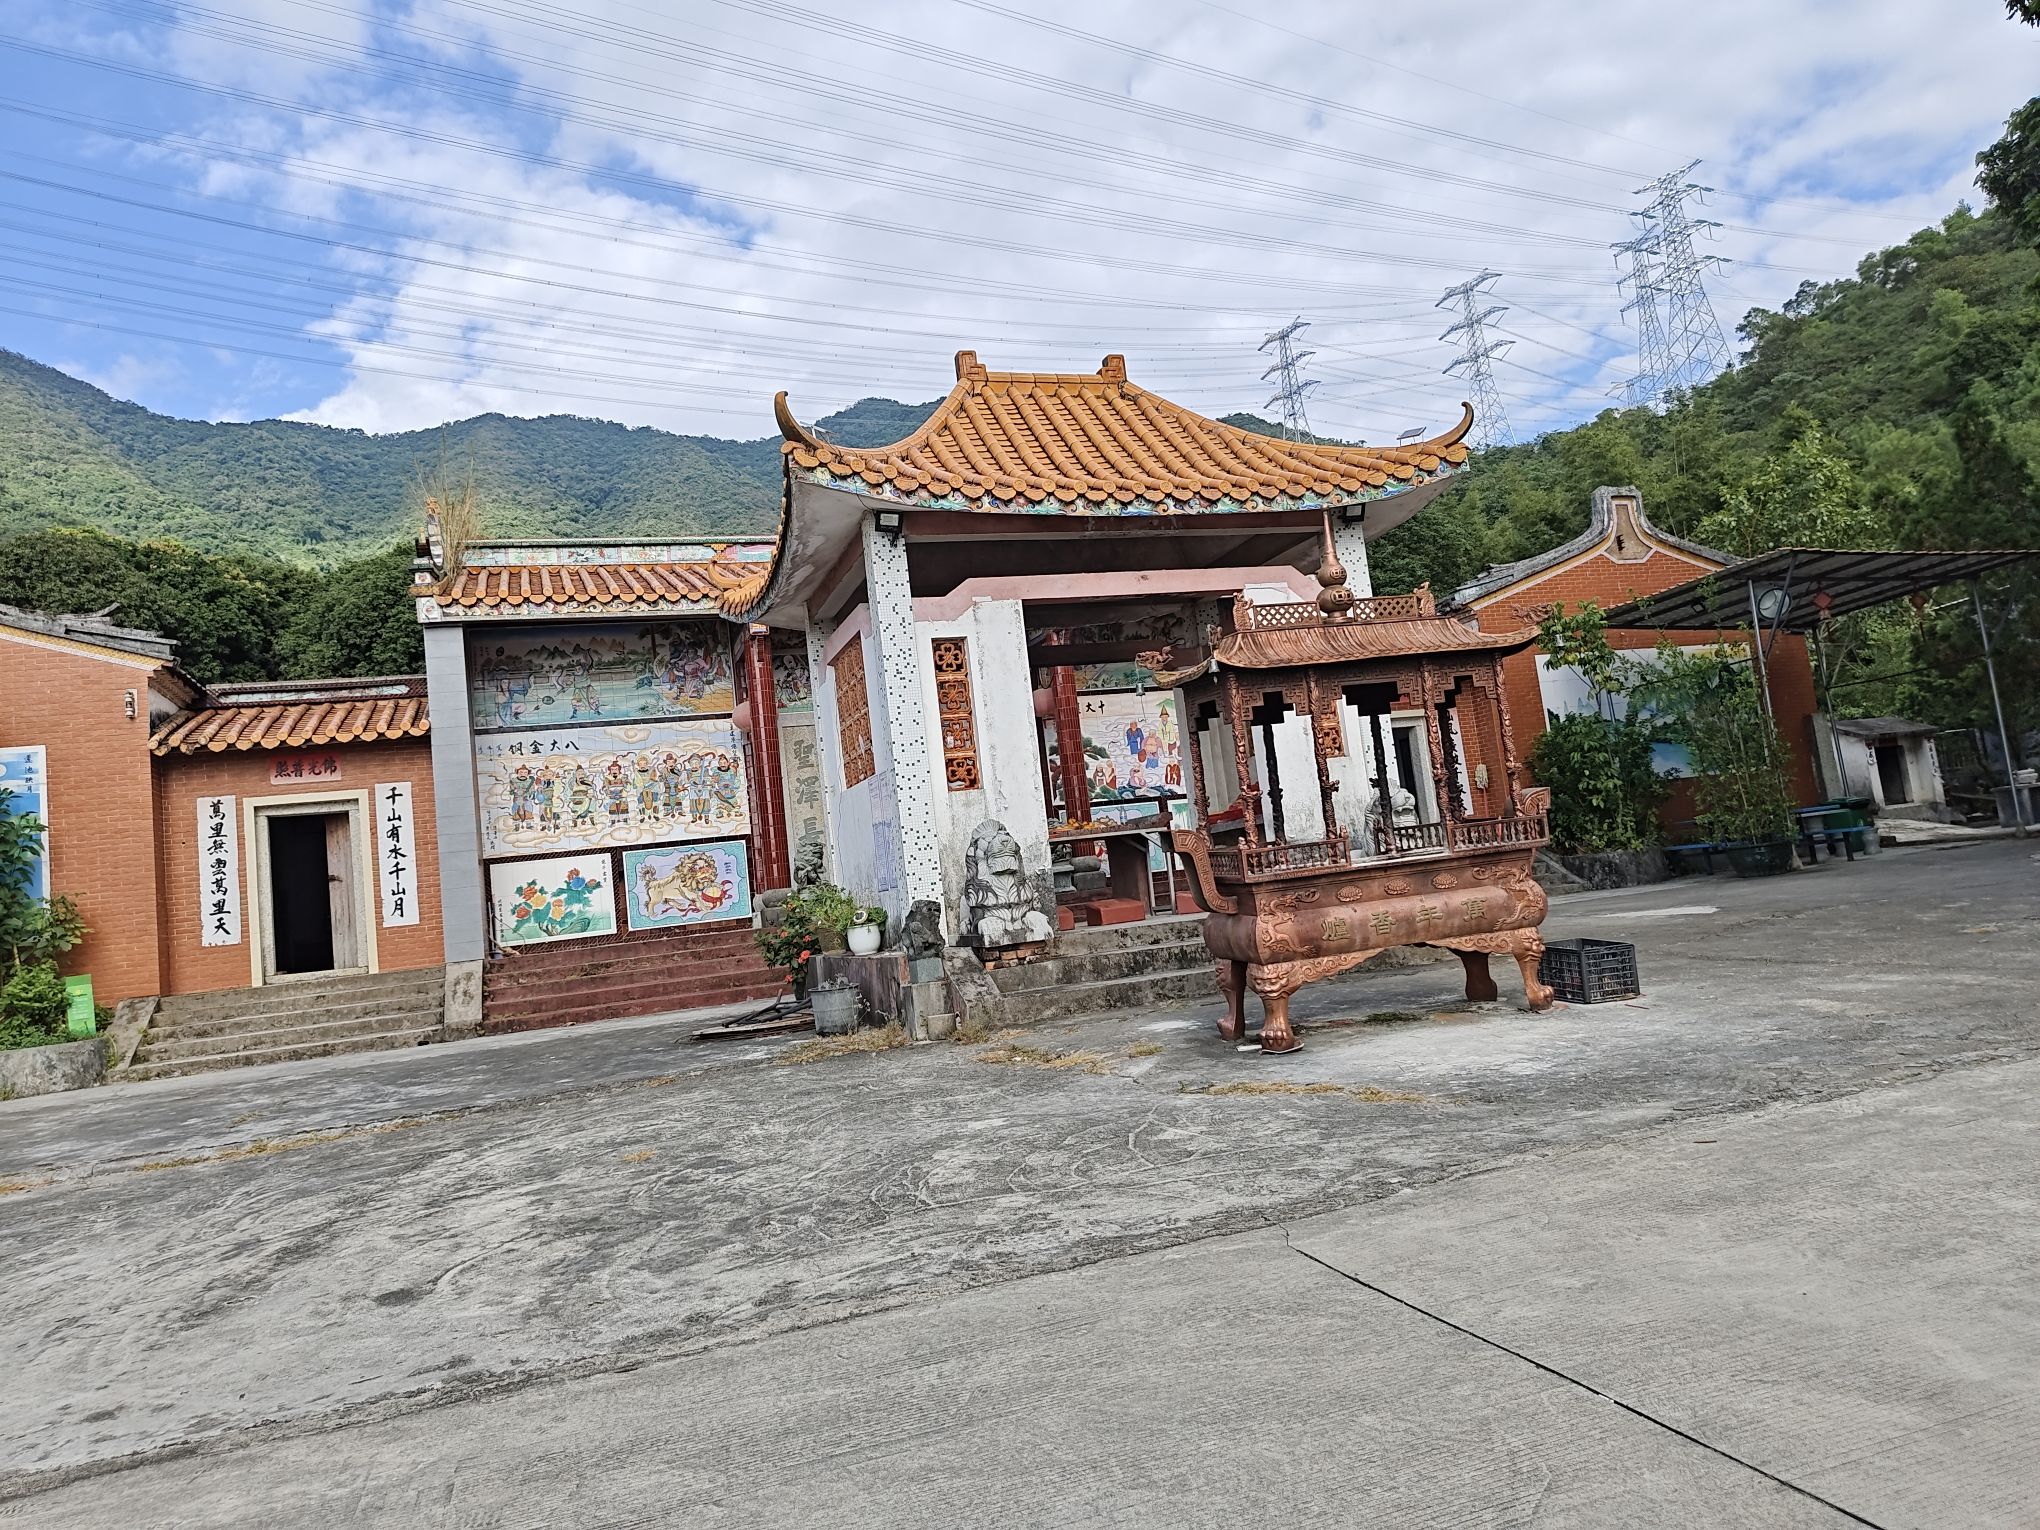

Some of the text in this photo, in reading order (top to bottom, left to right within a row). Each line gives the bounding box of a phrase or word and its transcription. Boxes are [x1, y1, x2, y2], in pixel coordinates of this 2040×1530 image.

[1077, 700, 1105, 715] 十大
[207, 799, 232, 935] 萬里無雲萬里天
[385, 786, 407, 917] 千山有水千山月
